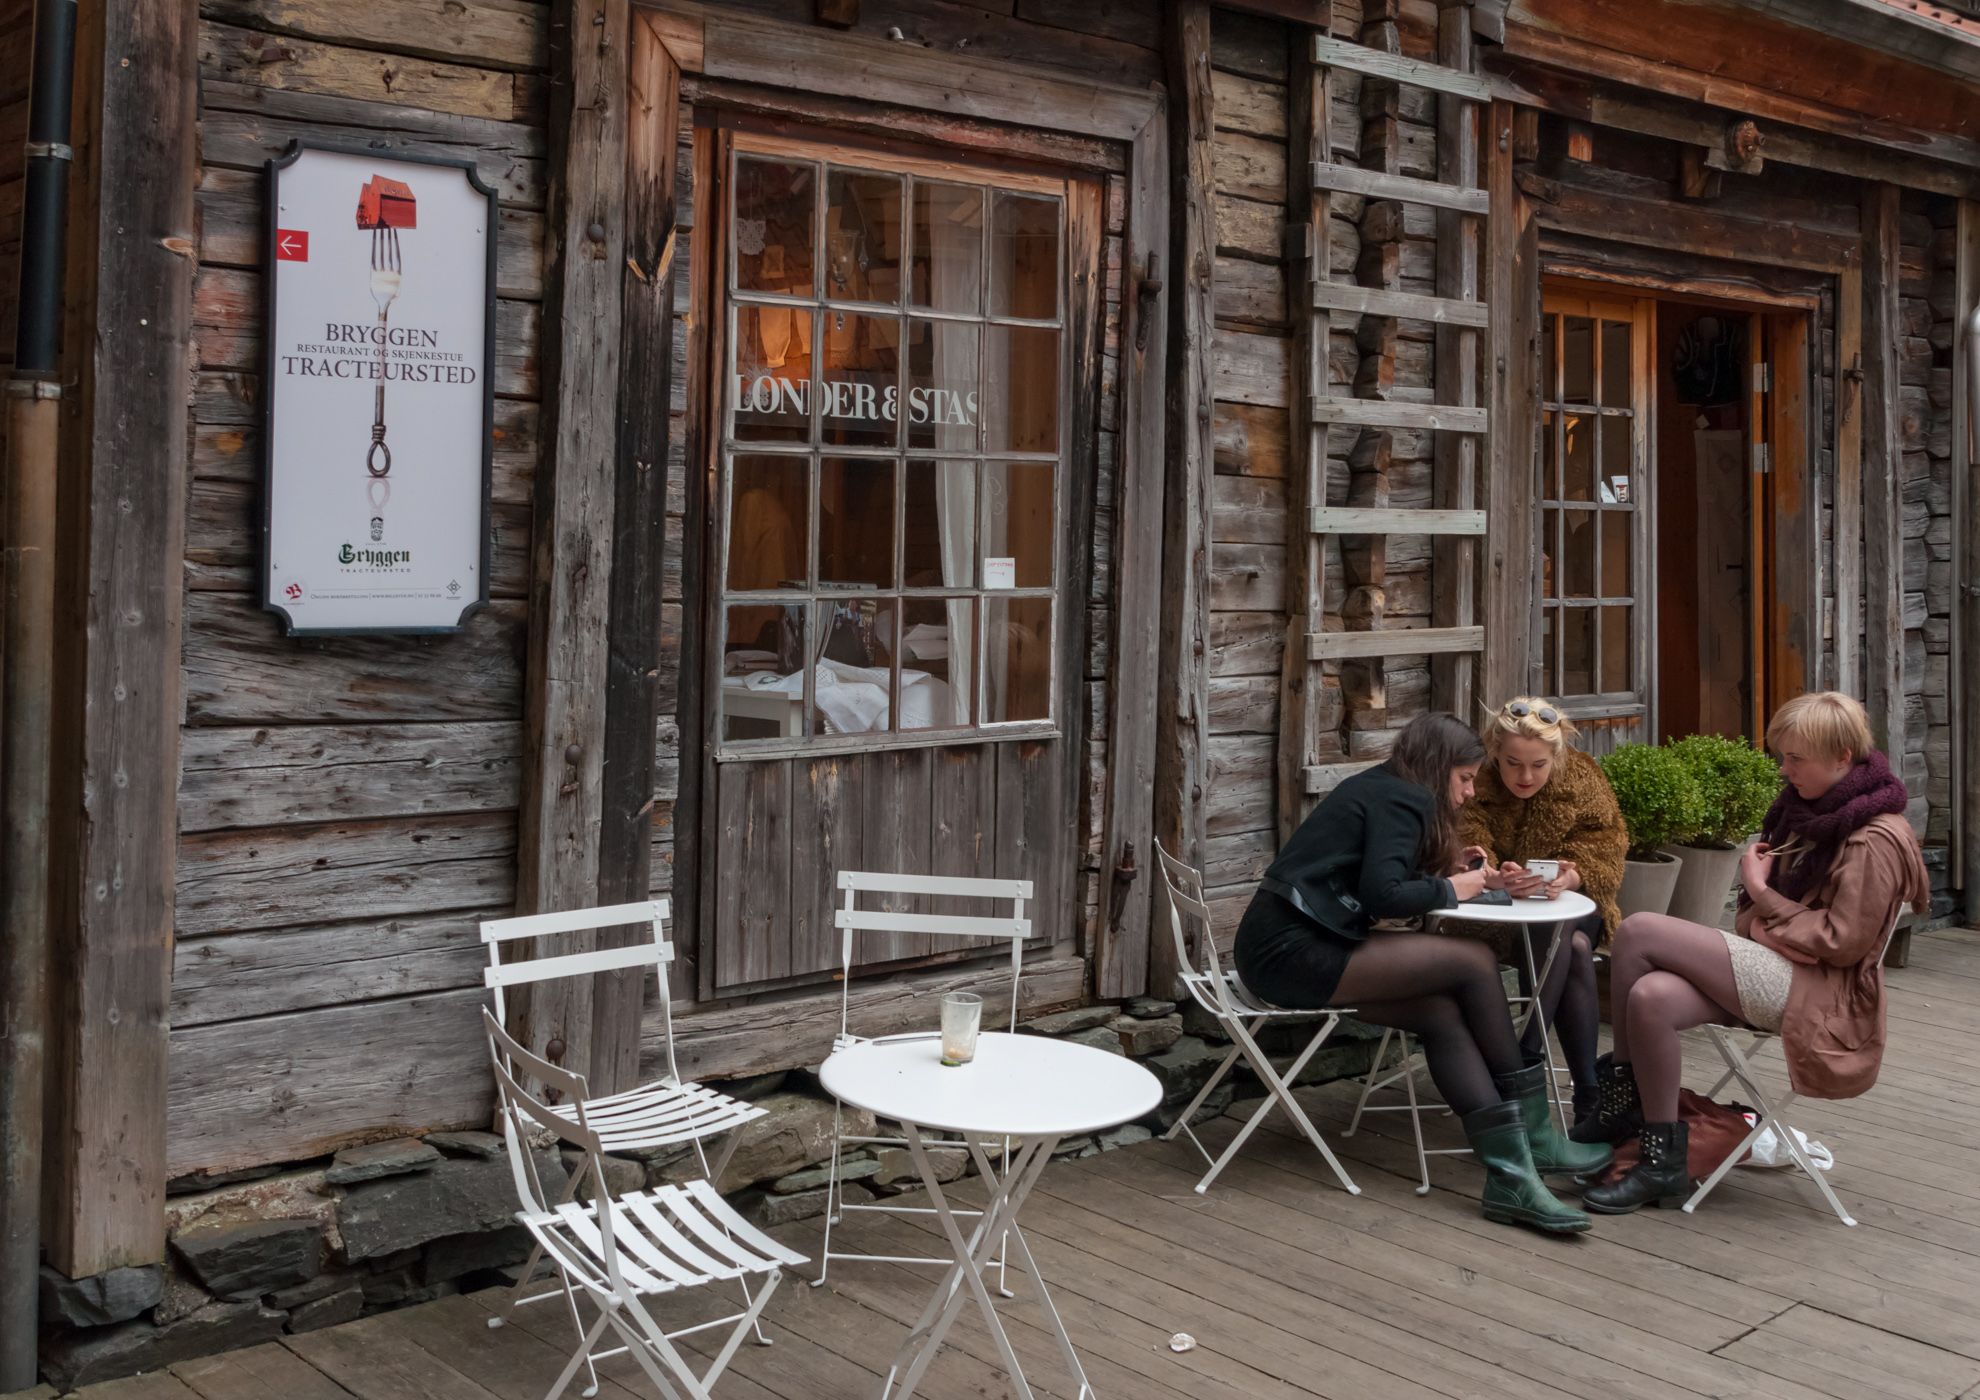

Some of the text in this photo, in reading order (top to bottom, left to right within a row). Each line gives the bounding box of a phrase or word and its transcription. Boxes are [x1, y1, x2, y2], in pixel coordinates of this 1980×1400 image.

[326, 323, 438, 348] BRYGGEN
[297, 343, 464, 362] RESTAURANT OG SKJENKESTUE
[282, 356, 476, 384] TRACTEURSTED
